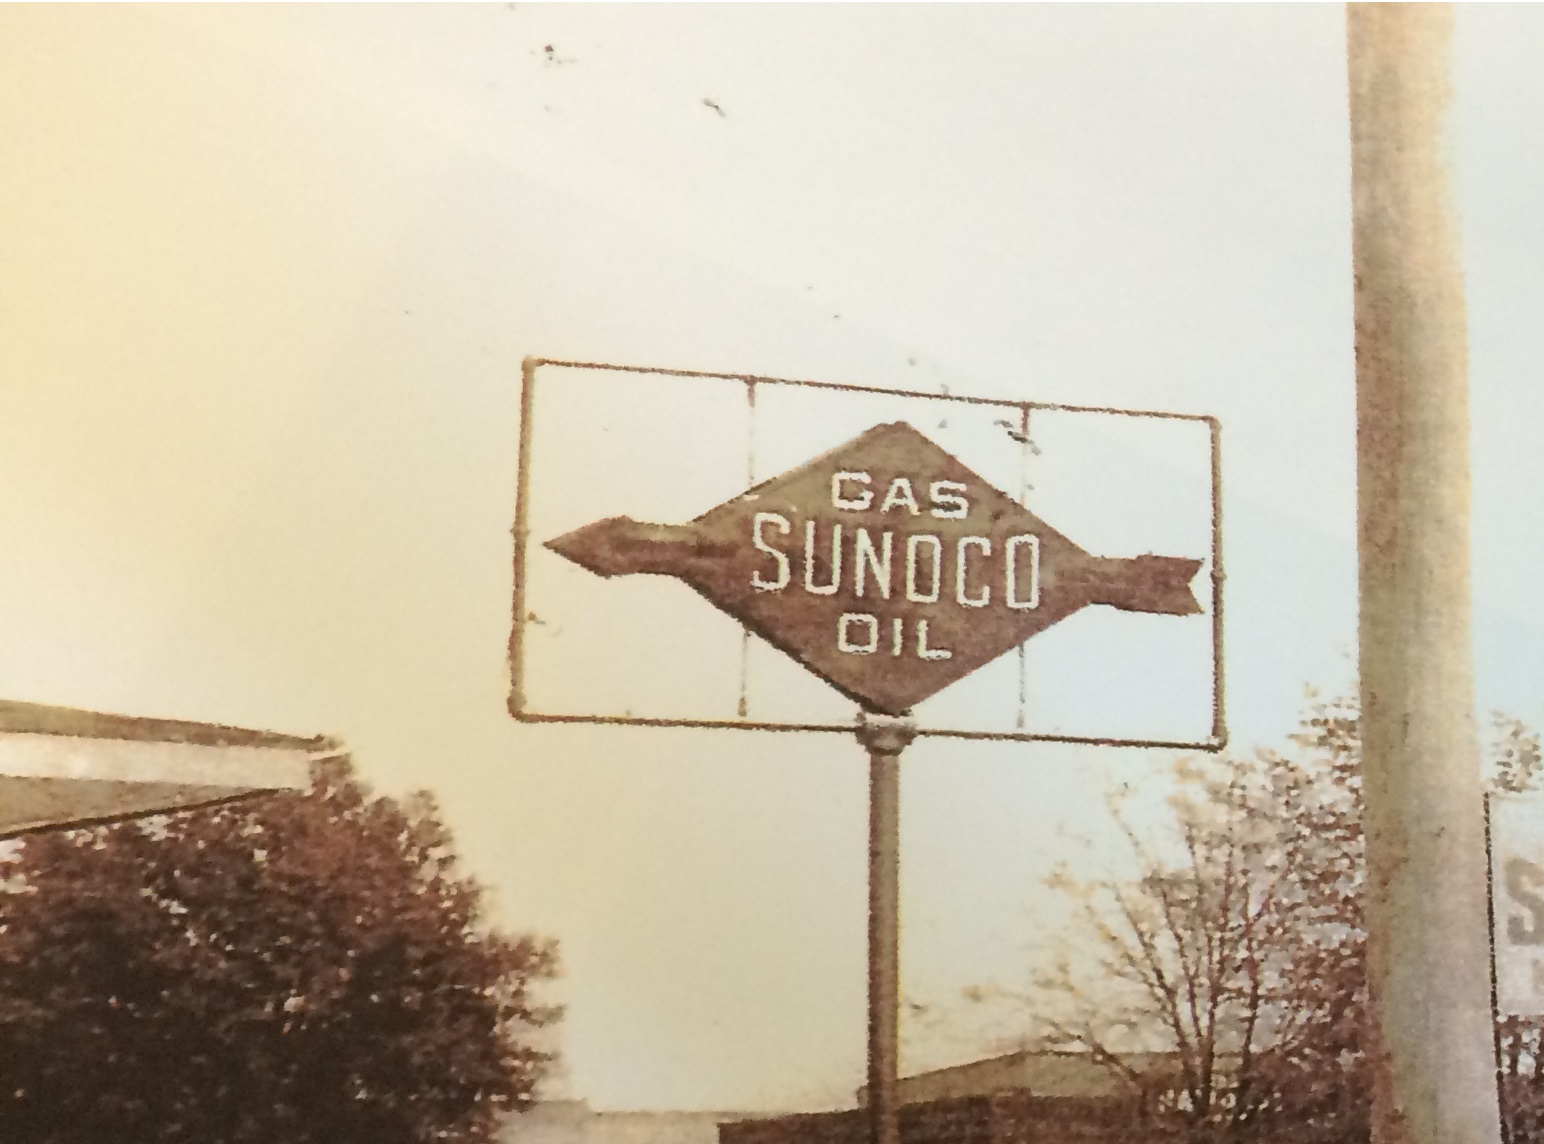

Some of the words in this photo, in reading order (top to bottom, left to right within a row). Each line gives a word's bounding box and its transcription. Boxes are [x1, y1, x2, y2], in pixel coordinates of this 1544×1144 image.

[831, 470, 970, 518] GAS
[750, 511, 1041, 610] SUNOCO
[836, 612, 952, 661] OIL
